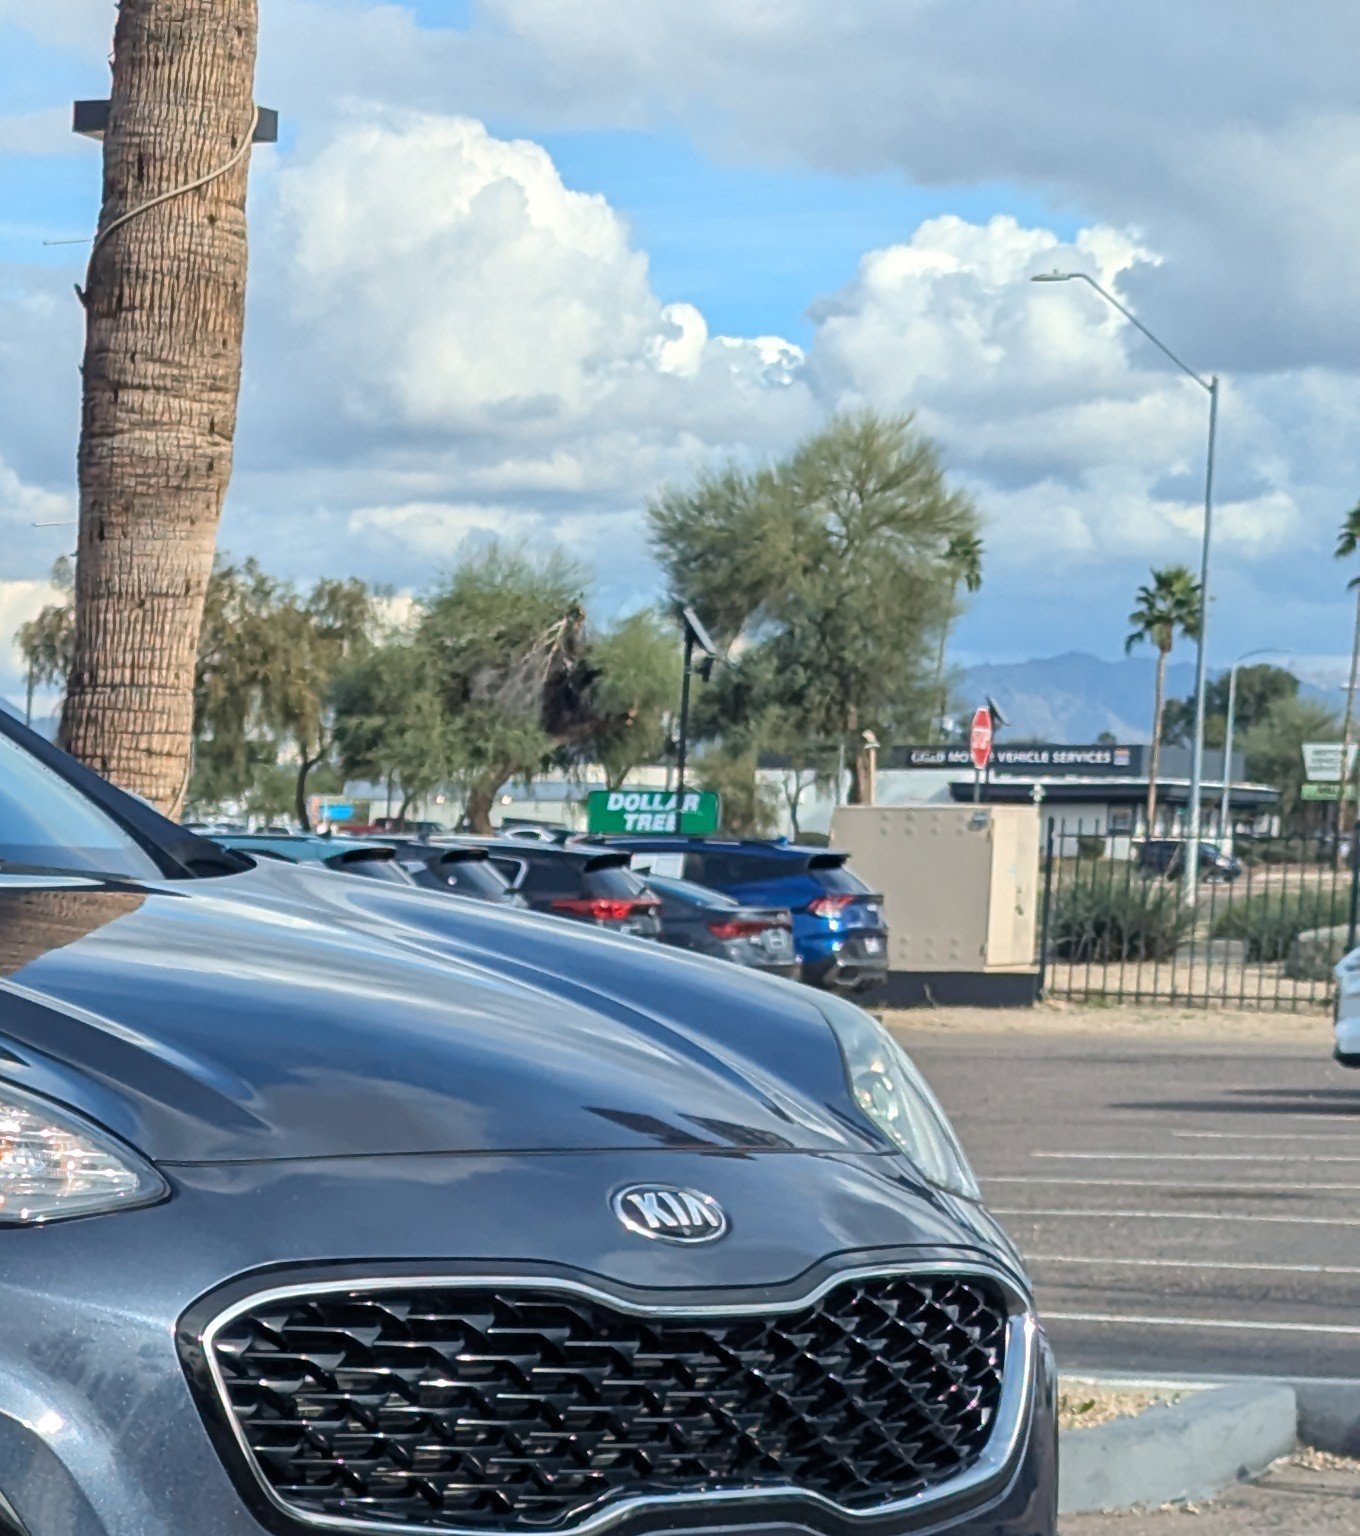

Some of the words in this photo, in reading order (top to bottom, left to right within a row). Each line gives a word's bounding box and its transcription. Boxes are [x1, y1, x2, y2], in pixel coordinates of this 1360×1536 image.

[997, 750, 1049, 764] VEHICLE
[1052, 750, 1111, 764] SERVICES
[626, 1191, 719, 1229] KIA
